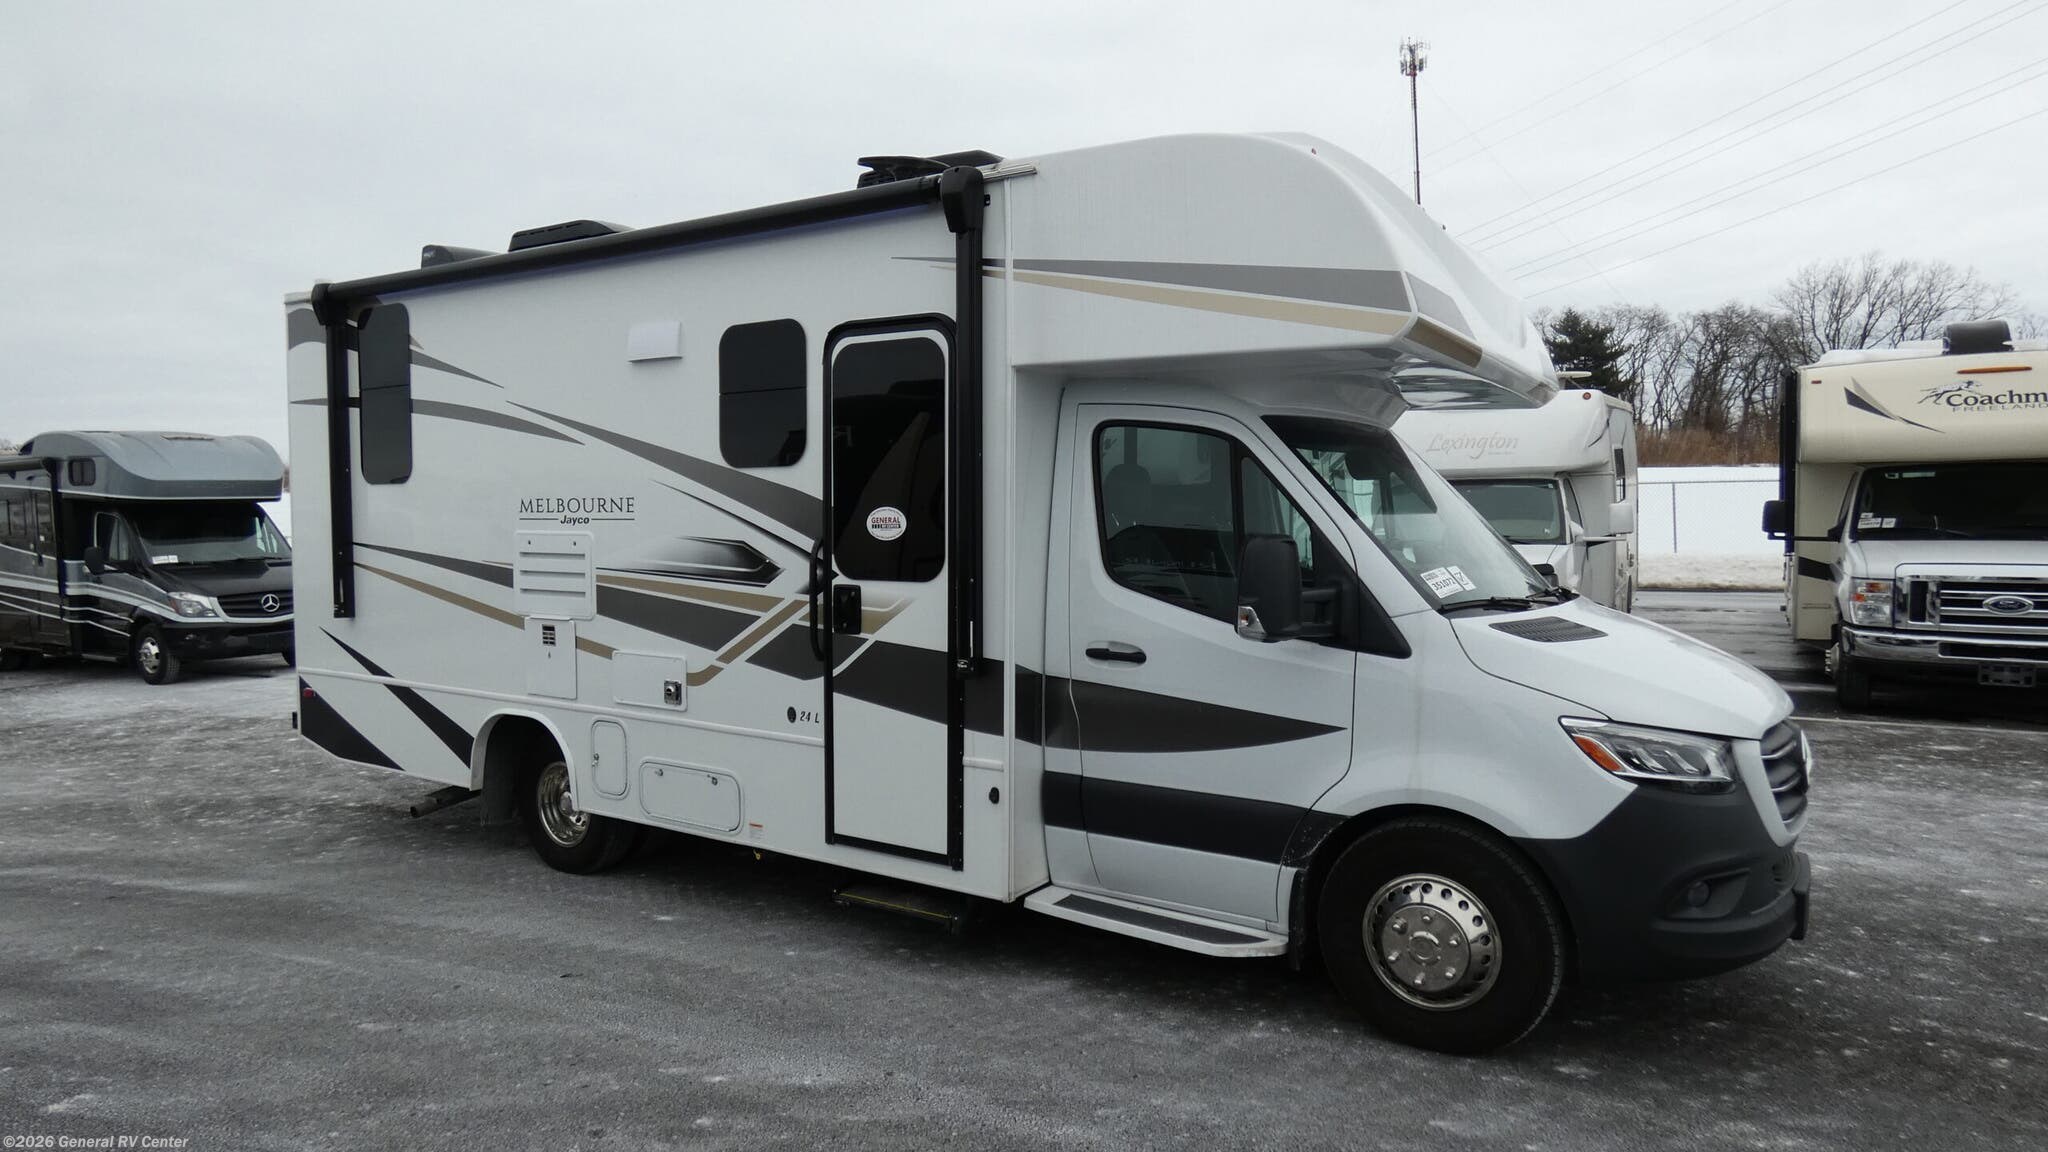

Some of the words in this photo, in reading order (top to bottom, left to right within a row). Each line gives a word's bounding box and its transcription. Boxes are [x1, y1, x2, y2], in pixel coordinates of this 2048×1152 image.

[1425, 431, 1519, 460] Lexington
[519, 496, 635, 513] MELBOURNE
[560, 515, 590, 526] Jayco
[871, 516, 901, 524] GENERAL
[799, 710, 811, 722] 24
[814, 711, 820, 724] L
